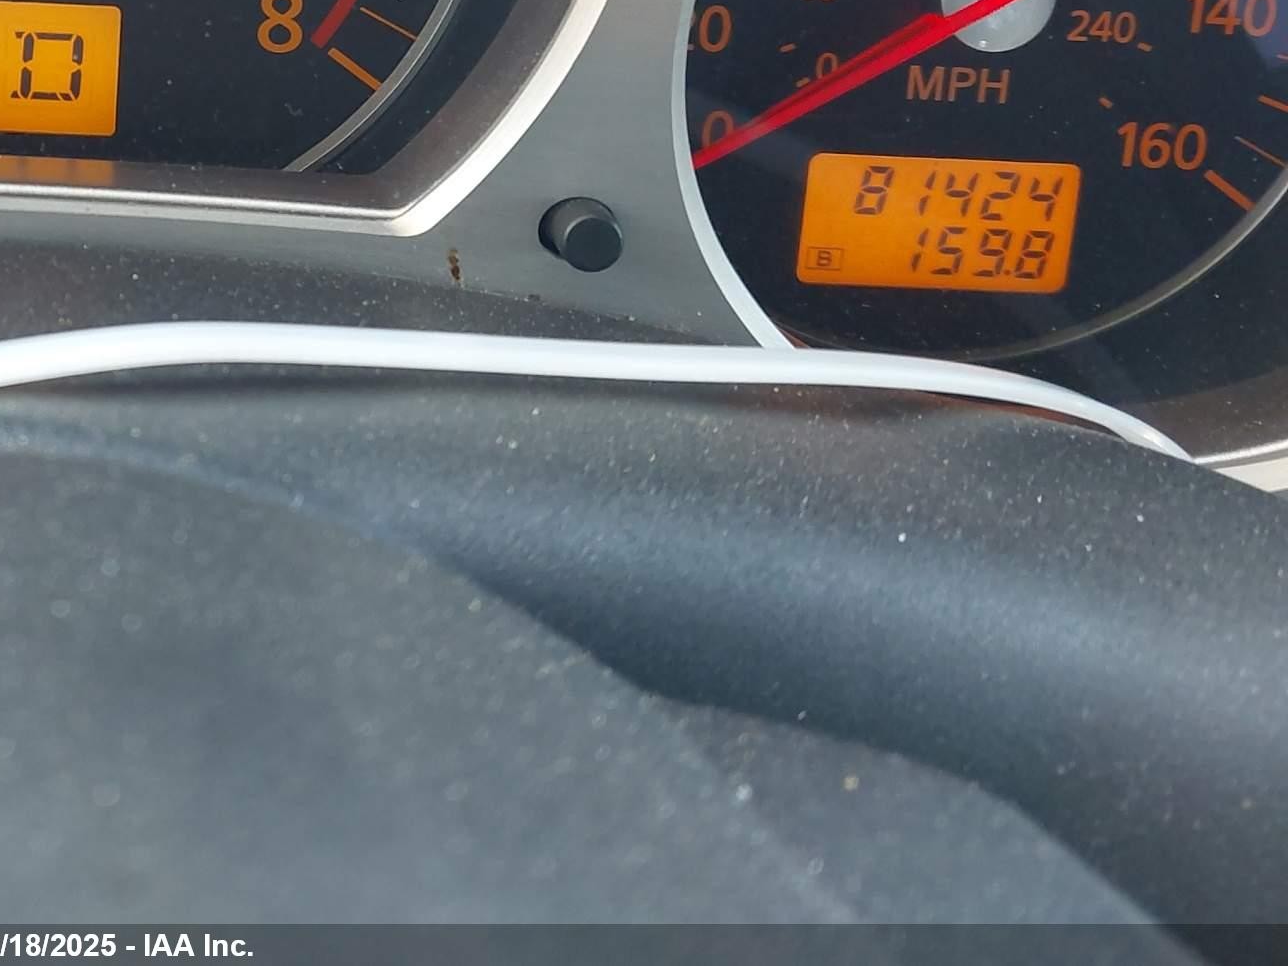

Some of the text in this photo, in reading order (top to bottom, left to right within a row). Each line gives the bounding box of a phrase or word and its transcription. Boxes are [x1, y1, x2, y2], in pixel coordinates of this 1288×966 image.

[1066, 9, 1137, 45] 240
[906, 65, 1011, 105] MPH
[1117, 121, 1207, 171] 160
[853, 165, 1064, 222] 81424
[910, 227, 1055, 280] 159.8
